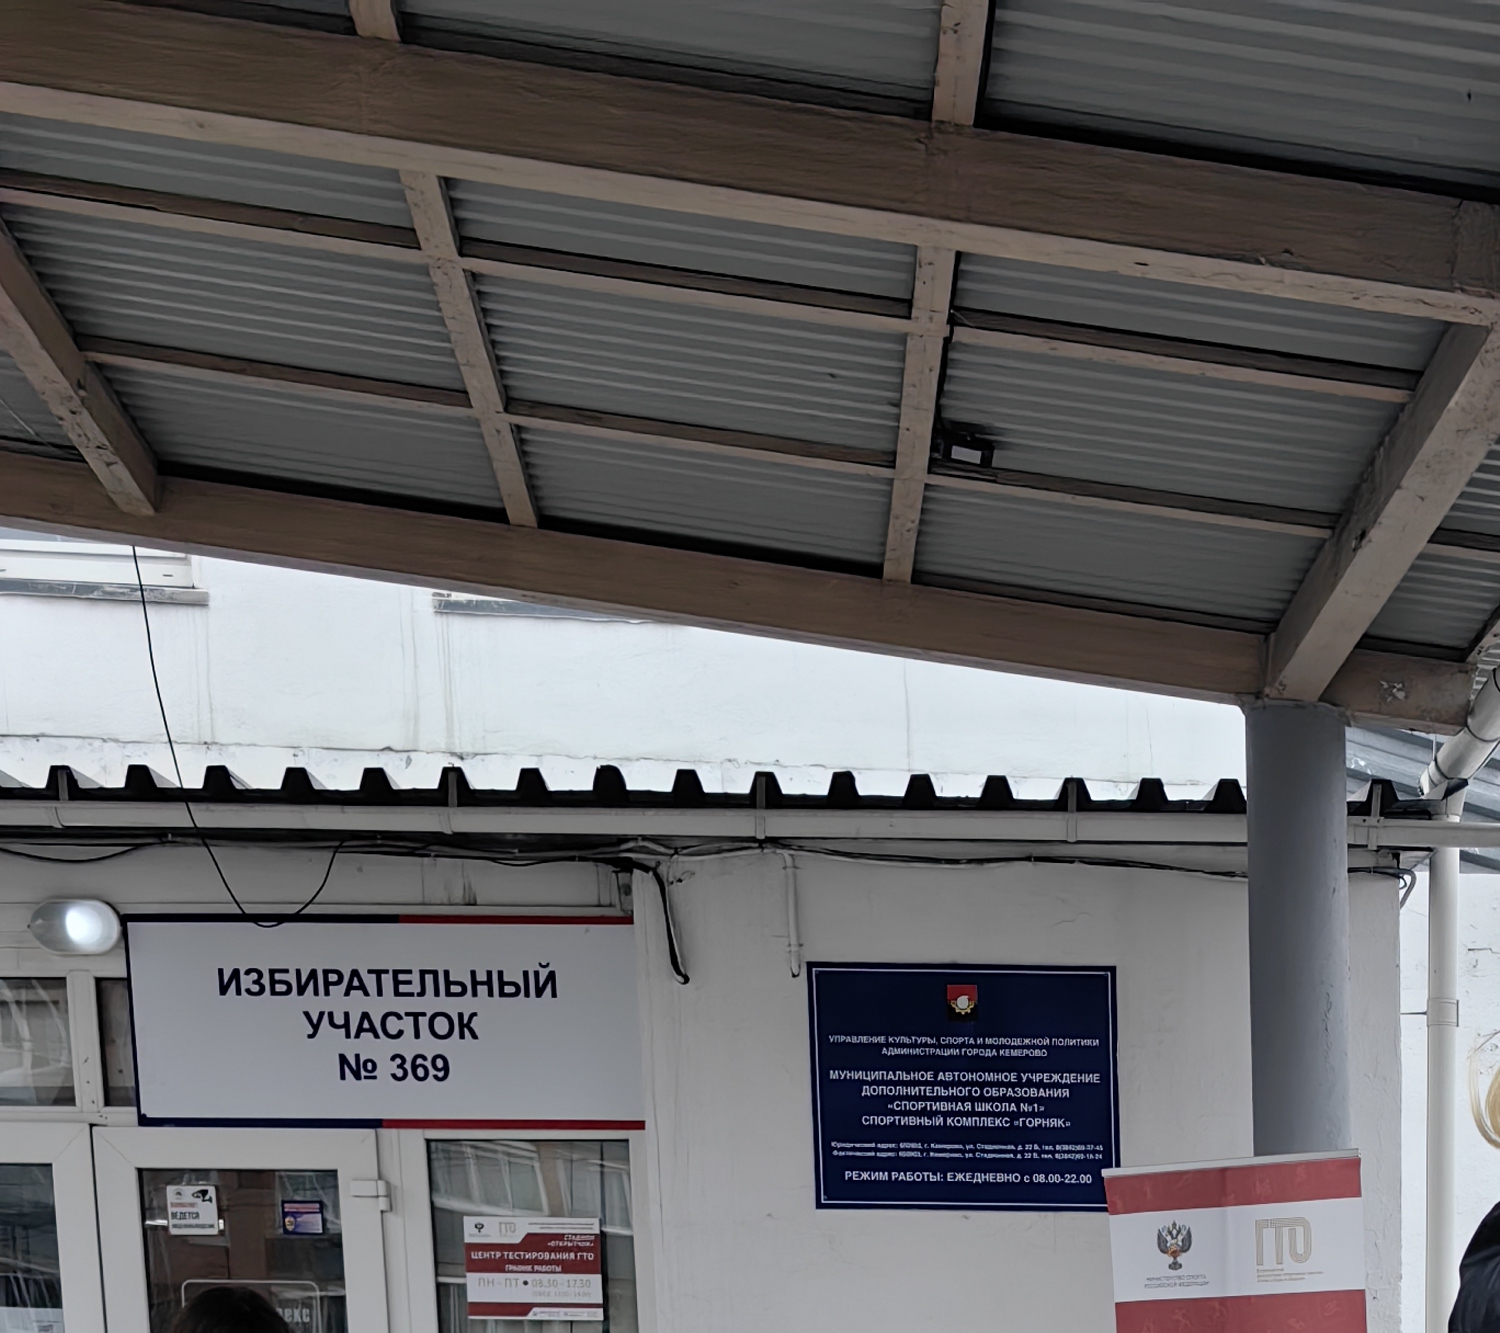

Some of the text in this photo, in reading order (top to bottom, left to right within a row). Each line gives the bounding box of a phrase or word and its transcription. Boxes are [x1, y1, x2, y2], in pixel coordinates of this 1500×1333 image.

[217, 962, 559, 999] ИЗБИРАТЕЛЬНЫЙ
[302, 1011, 479, 1041] УЧАСТОК
[829, 1035, 887, 1044] УПРАВЛЕНИЕ
[889, 1036, 938, 1046] КУЛЬТУРЫ,
[940, 1036, 975, 1045] СПОРТА
[977, 1037, 983, 1045] И
[1052, 1038, 1099, 1047] ПОЛИТИКИ
[881, 1047, 1047, 1058] АДМИНИСТРАЦИИ ГОРОДА КЕМЕРОВО
[337, 1052, 451, 1083] № 369
[829, 1070, 1101, 1084] МУНИЦИПАЛЬНОЕ АВТОНОМНОЕ УЧРЕЖДЕНИЕ
[861, 1085, 1070, 1098] ДОПОЛНИТЕЛЬНОГО ОБРАЗОВАНИЯ
[888, 1101, 972, 1111] «СПОРТИВНАЯ
[975, 1102, 1018, 1112] ШКОЛА
[862, 1114, 1071, 1128] СПОРТИВНЫЙ КОМПЛЕКС «ГОРНЯК»
[844, 1171, 888, 1182] РЕЖИМ
[891, 1171, 944, 1182] РАБОТЫ:
[947, 1172, 1021, 1184] ЕЖЕДНЕВНО
[1032, 1173, 1092, 1184] 08.00-22.00
[503, 1252, 575, 1260] ТЕСТИРОВАНИЯ
